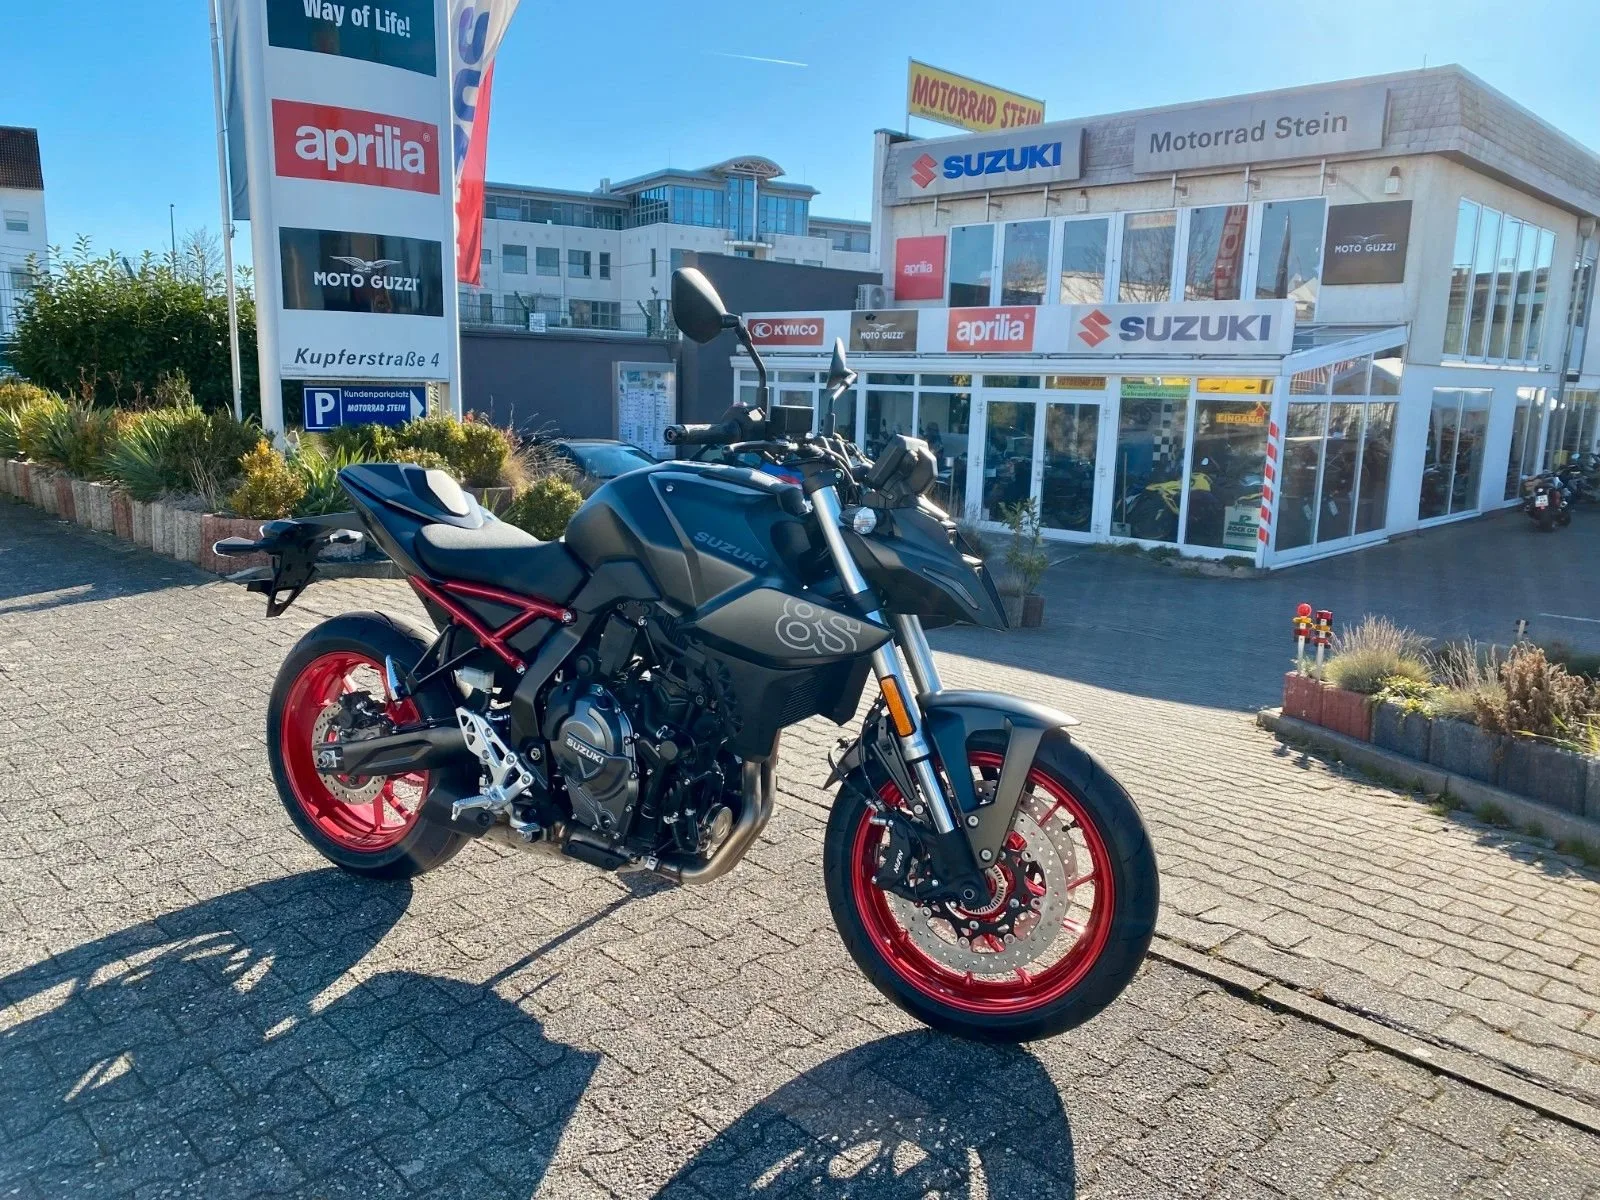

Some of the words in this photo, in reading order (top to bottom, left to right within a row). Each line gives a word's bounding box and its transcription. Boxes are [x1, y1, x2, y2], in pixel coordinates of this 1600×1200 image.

[303, 0, 345, 26] Way
[351, 5, 370, 27] of
[375, 8, 411, 38] Life!
[912, 73, 997, 125] MOTORRAD
[1000, 101, 1041, 128] STEIN
[1150, 119, 1266, 153] Motorrad
[1275, 112, 1348, 139] Stein
[295, 124, 426, 175] aprilia
[942, 142, 1062, 179] SUZUKI
[1335, 244, 1361, 254] MOTO
[1365, 243, 1395, 252] GUZZI
[314, 271, 364, 288] MOTO
[371, 275, 418, 292] GUZZI
[904, 261, 933, 276] aprilia
[774, 324, 818, 336] KYMCO
[860, 331, 880, 340] MOTO
[882, 331, 904, 340] GUZZI
[956, 313, 1024, 346] aprilia
[1118, 314, 1272, 342] SUZUKI
[294, 347, 425, 368] Kupferstraße
[431, 352, 440, 367] 4
[344, 389, 410, 399] Kundenparkplatz
[347, 403, 385, 412] MOTORRAD
[386, 404, 406, 412] STEIN
[314, 392, 336, 425] P
[1218, 414, 1263, 423] EINGANG
[694, 531, 769, 569] SUZUKI
[566, 737, 604, 764] SUZUKI
